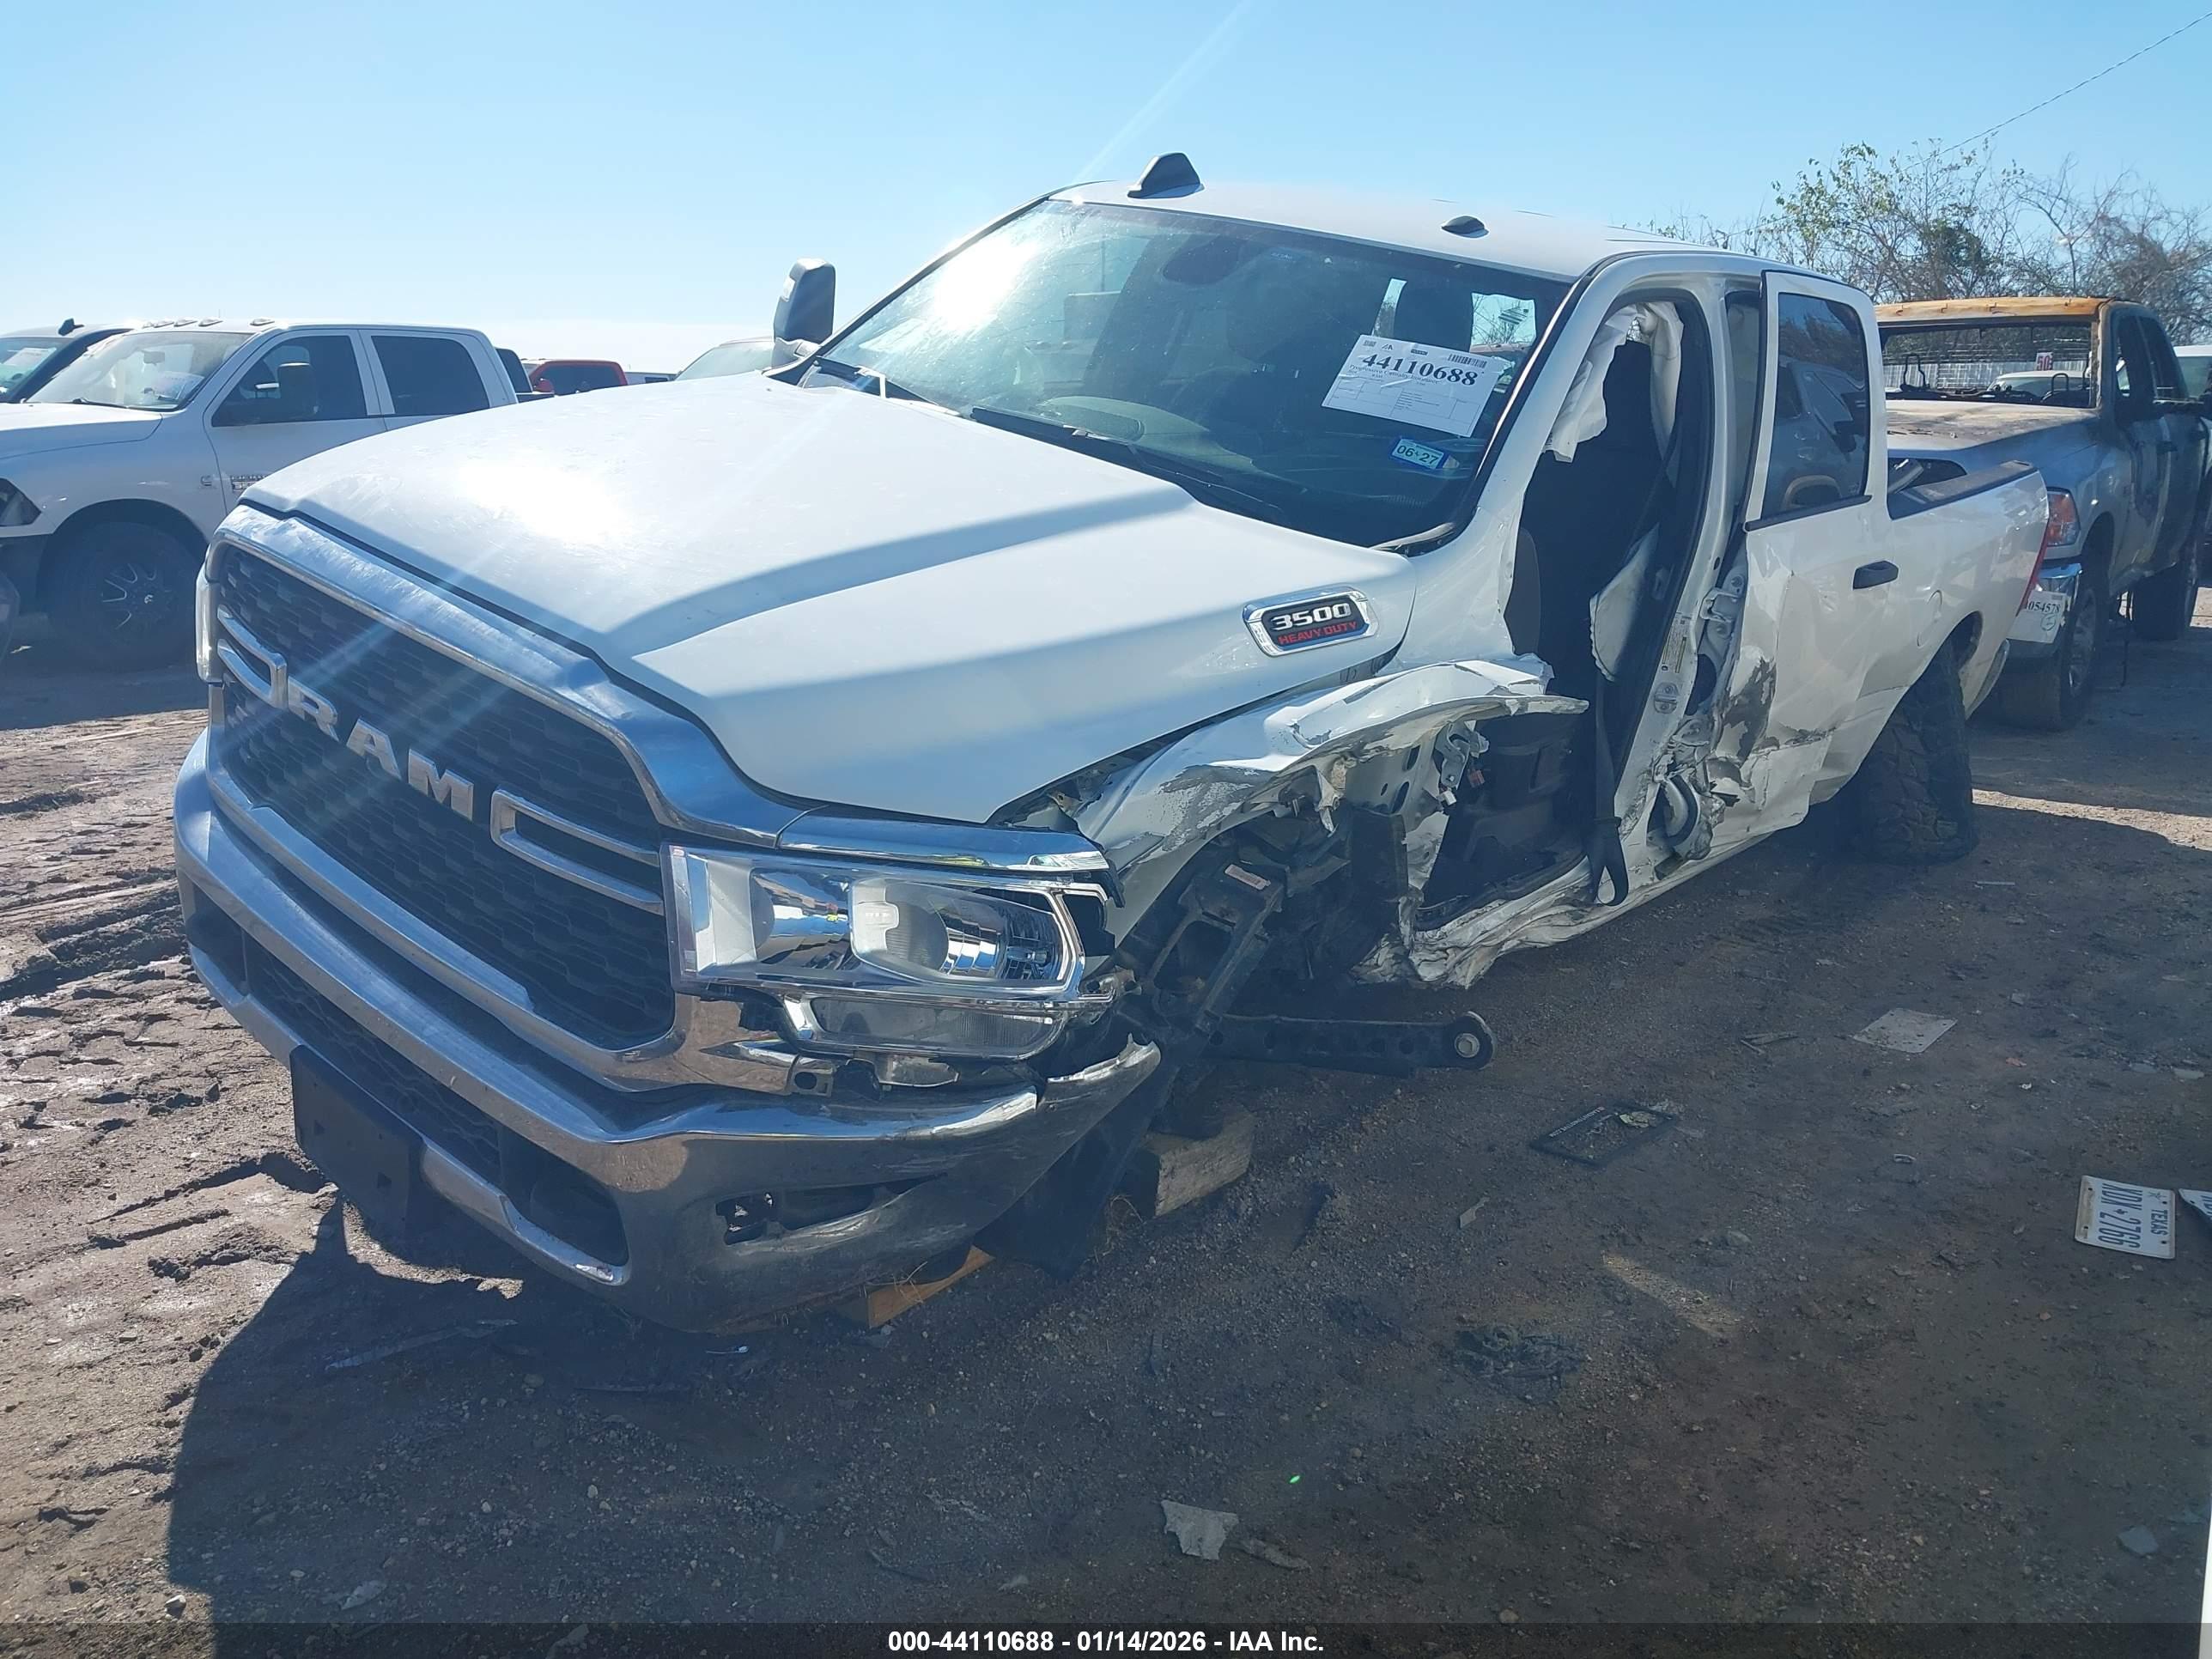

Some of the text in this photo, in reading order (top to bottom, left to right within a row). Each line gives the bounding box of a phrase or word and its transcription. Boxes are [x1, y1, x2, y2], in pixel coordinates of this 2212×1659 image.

[1362, 353, 1478, 386] 44110688
[1396, 445, 1438, 465] 06 27
[1272, 602, 1352, 631] 3500
[1277, 621, 1358, 645] HEAVY DUTY
[289, 675, 474, 823] RAM
[2097, 1212, 2142, 1249] 2766
[2150, 1209, 2169, 1236] TEXAS
